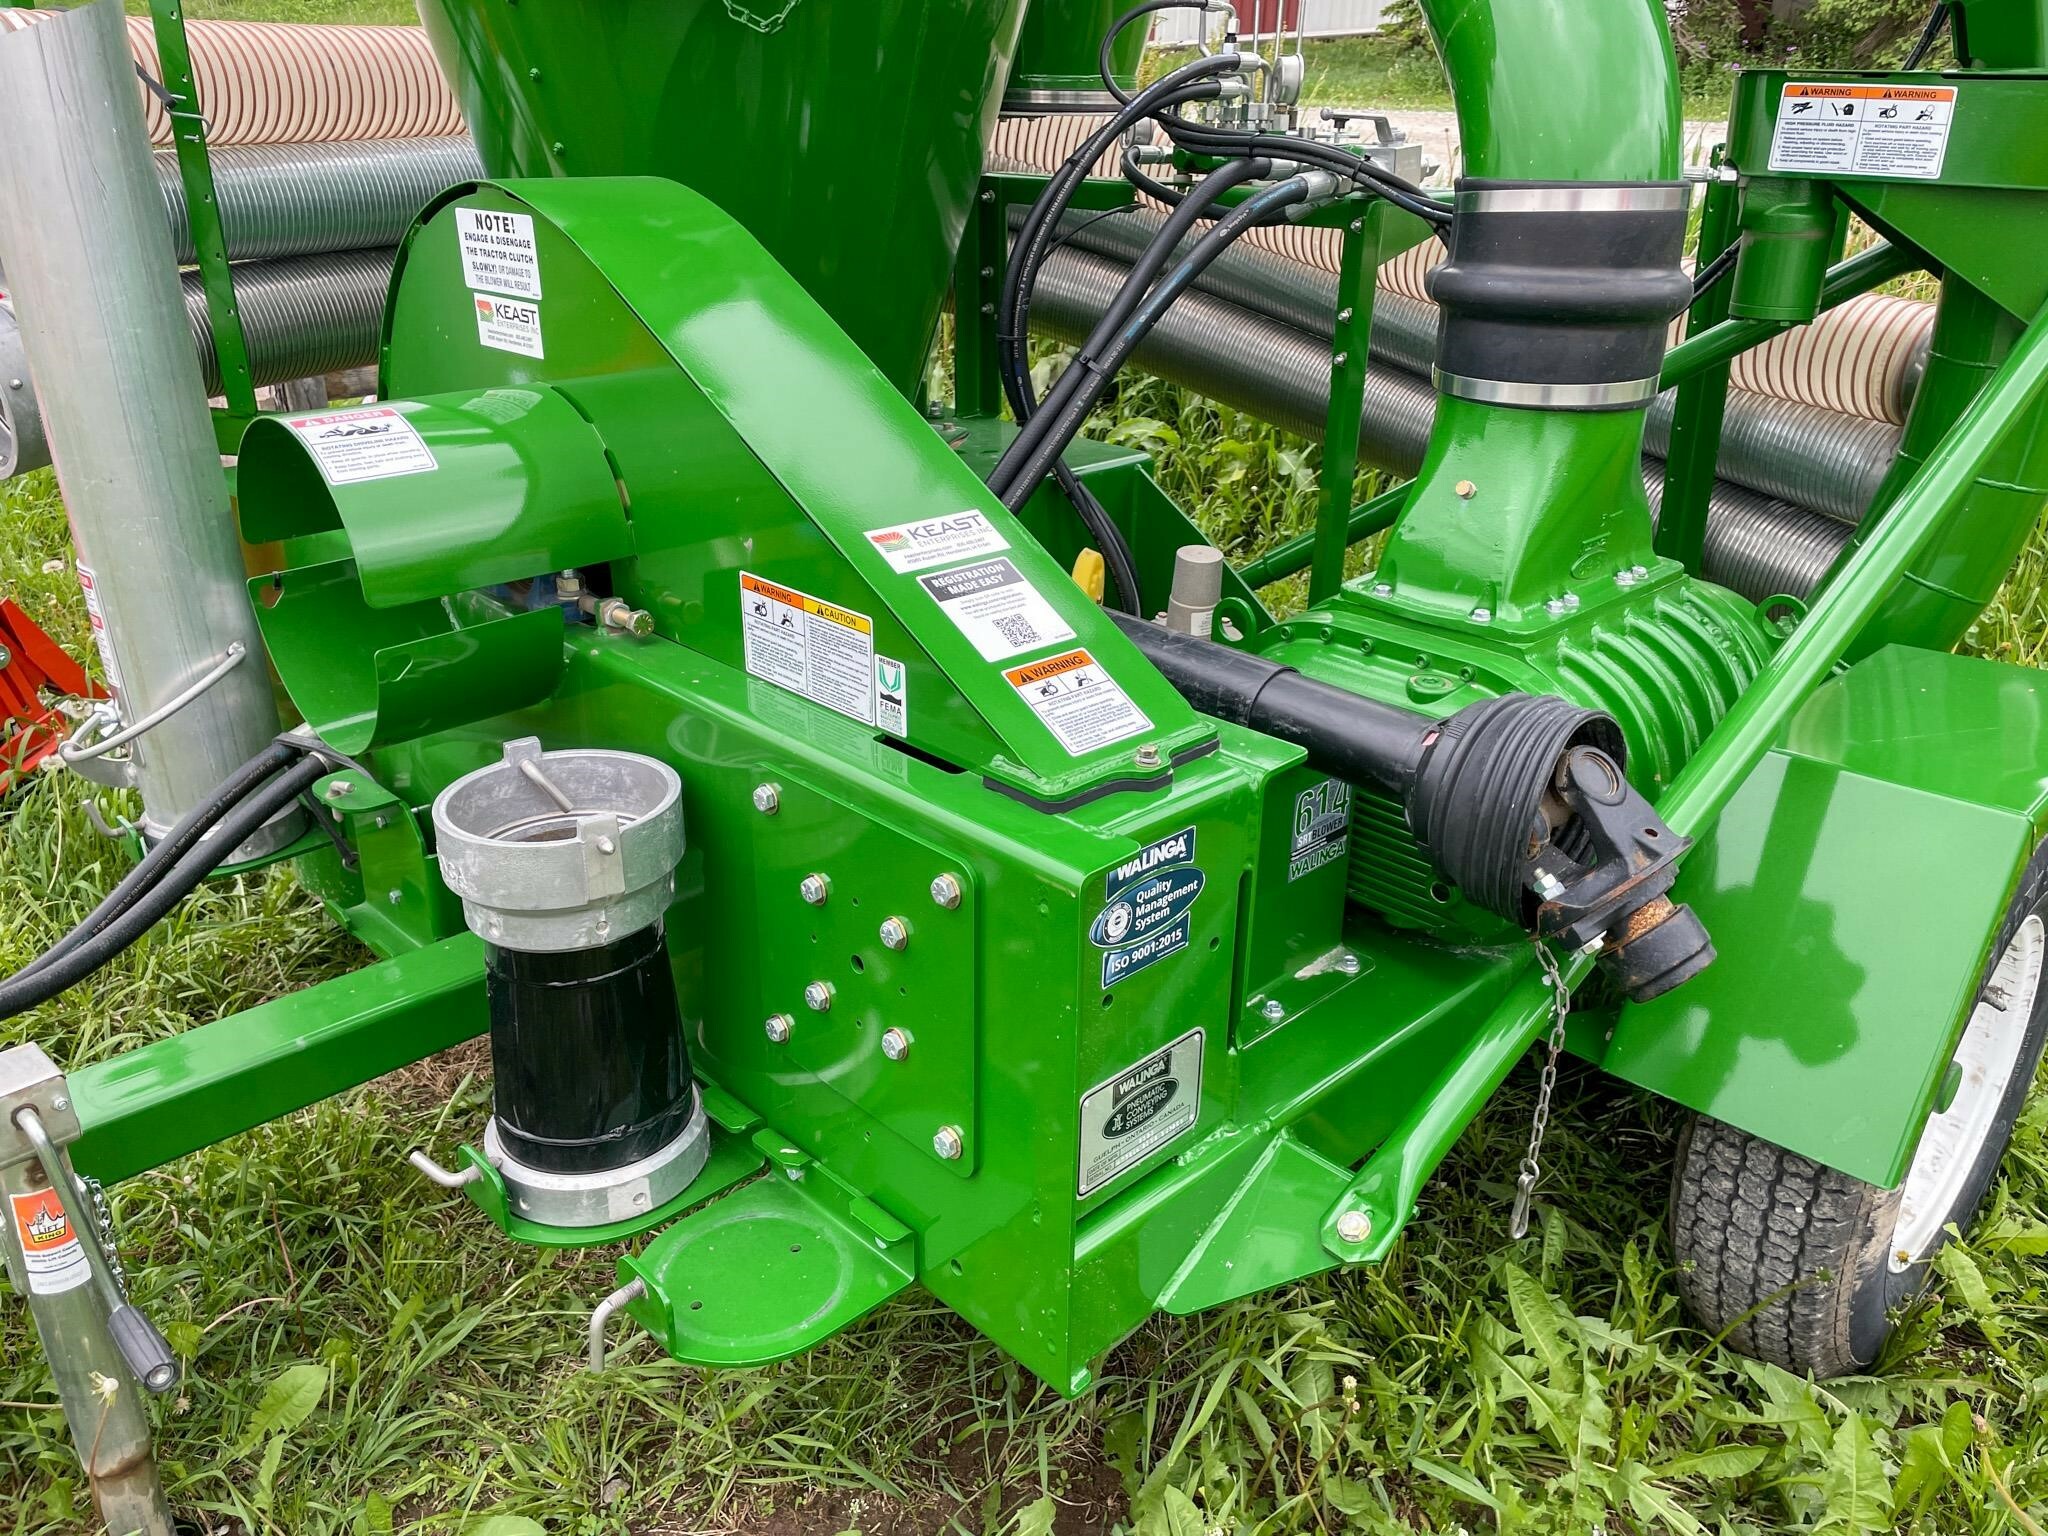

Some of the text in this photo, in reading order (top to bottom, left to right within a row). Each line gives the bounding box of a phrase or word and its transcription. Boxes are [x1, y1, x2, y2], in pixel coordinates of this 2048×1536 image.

[1810, 87, 1852, 96] WARNING
[1893, 89, 1937, 99] WARNING
[474, 213, 515, 234] NOTE!
[464, 232, 489, 244] ENGAGE
[496, 236, 531, 249] DISENGAGE
[466, 246, 534, 264] THE TRACTOR CLUTCH
[472, 261, 532, 279] SLOWLY! OR DAMAGE TO
[475, 273, 531, 292] THE BLOWER WILL RESULT
[495, 303, 537, 325] KEAST
[496, 319, 530, 333] ENTERPRISES
[322, 411, 384, 425] DANGER
[907, 514, 983, 540] KEAST
[916, 530, 979, 548] ENTERPRISES
[931, 563, 1006, 588] REGISTRATION
[947, 574, 1005, 595] MADE EASY
[760, 584, 792, 603] WARNING
[824, 608, 857, 627] CAUTION
[879, 657, 900, 670] MEMBER
[1030, 655, 1084, 678] WARNING
[880, 700, 902, 716] FEMA
[1295, 781, 1350, 838] 614
[1117, 838, 1187, 881] WALINGA
[1289, 840, 1346, 880] WALINGA
[1135, 879, 1199, 918] Management
[1136, 879, 1173, 902] Quality
[1134, 906, 1170, 932] System
[1111, 956, 1129, 974] ISO
[1131, 928, 1182, 962] 9001:2015
[1118, 1059, 1166, 1095] WALINGA
[1126, 1082, 1166, 1112] PNEUMATIC
[1126, 1090, 1168, 1120] CONVEYING
[1125, 1107, 1154, 1130] SYSTEMS
[1093, 1142, 1121, 1163] GUELPH
[1125, 1120, 1155, 1144] ONTARIO
[1158, 1102, 1185, 1122] CANADA
[37, 1230, 62, 1241] KING
[39, 1222, 59, 1235] LIFT
